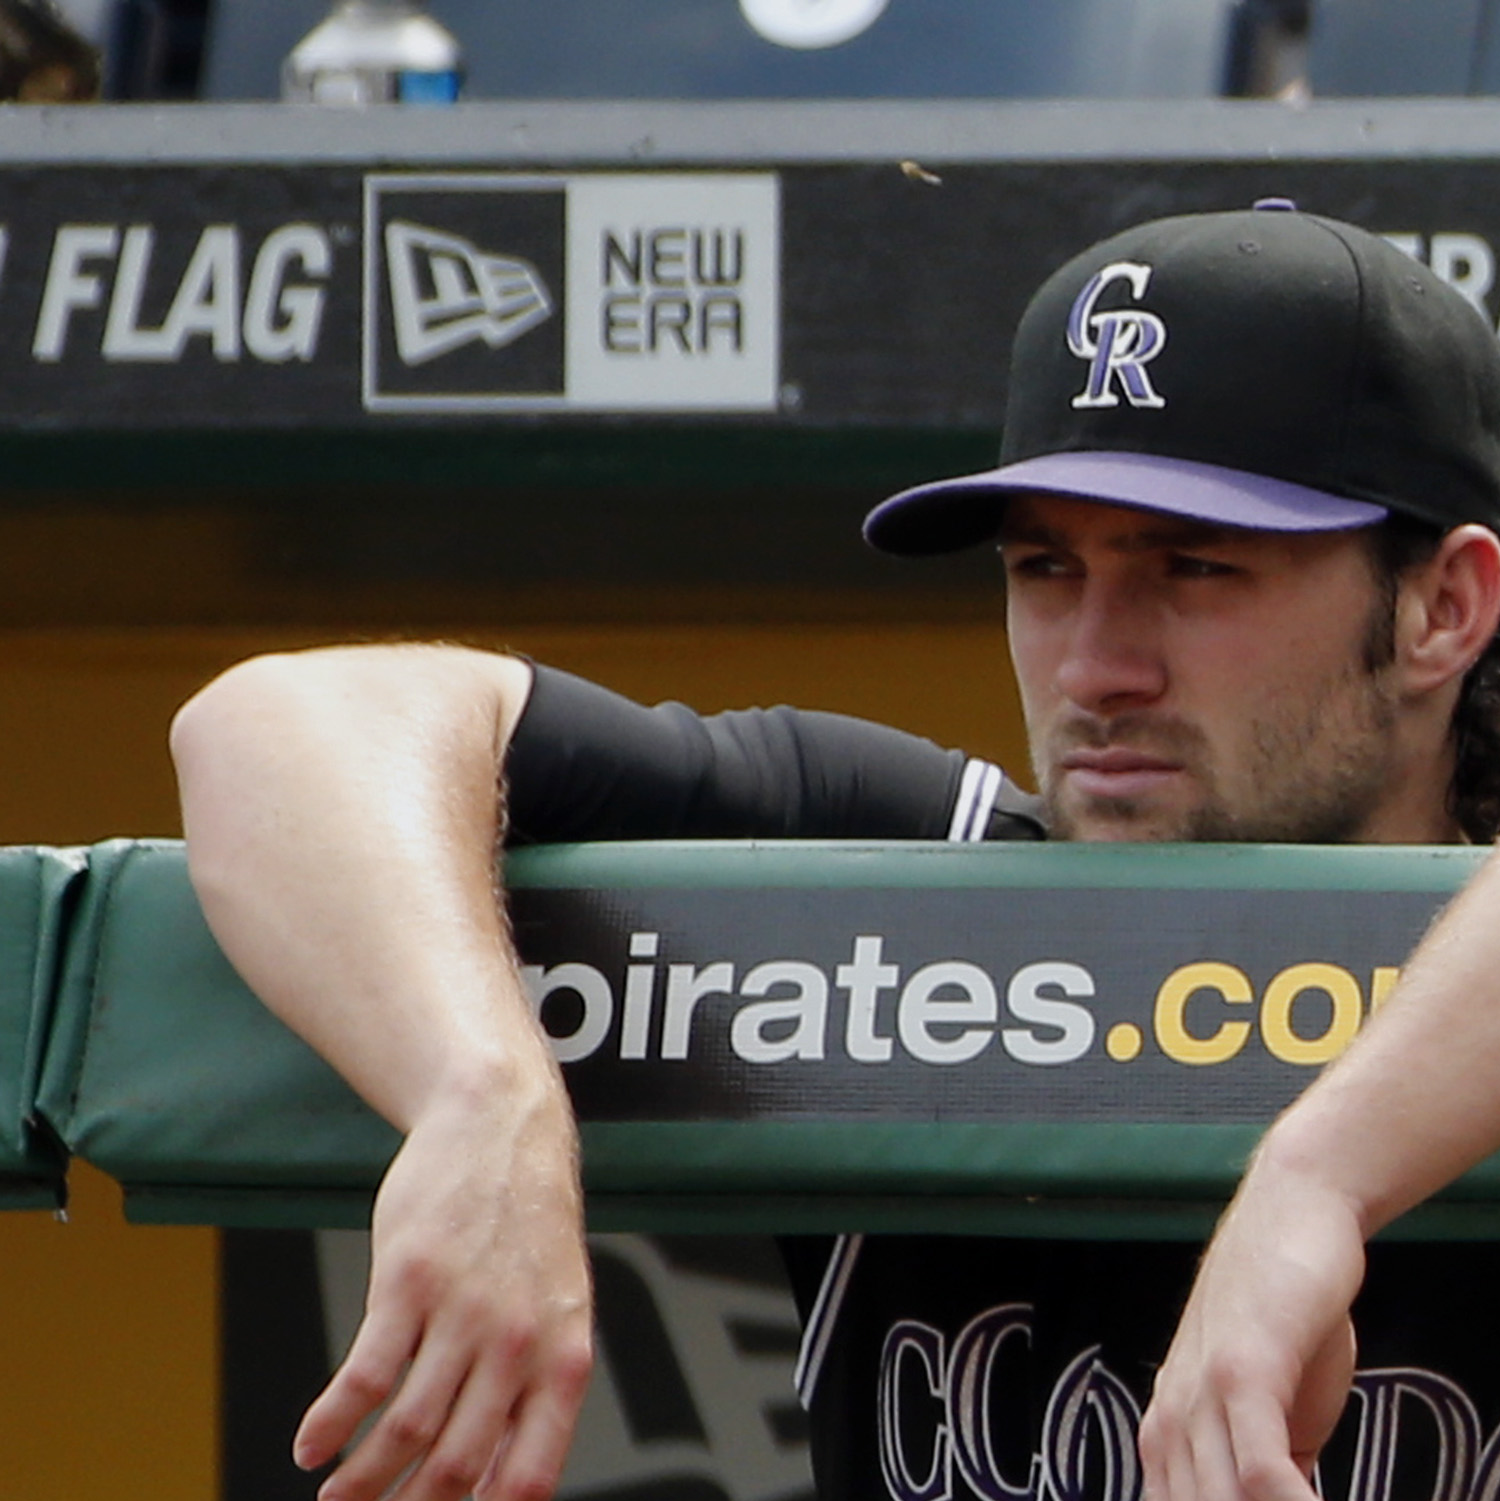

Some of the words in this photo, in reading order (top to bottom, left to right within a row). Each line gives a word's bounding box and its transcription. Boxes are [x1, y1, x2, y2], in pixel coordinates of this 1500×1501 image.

[32, 221, 333, 364] FLAG
[603, 225, 743, 287] NEW
[603, 294, 743, 355] ERA
[515, 932, 1400, 1067] pirates.co
